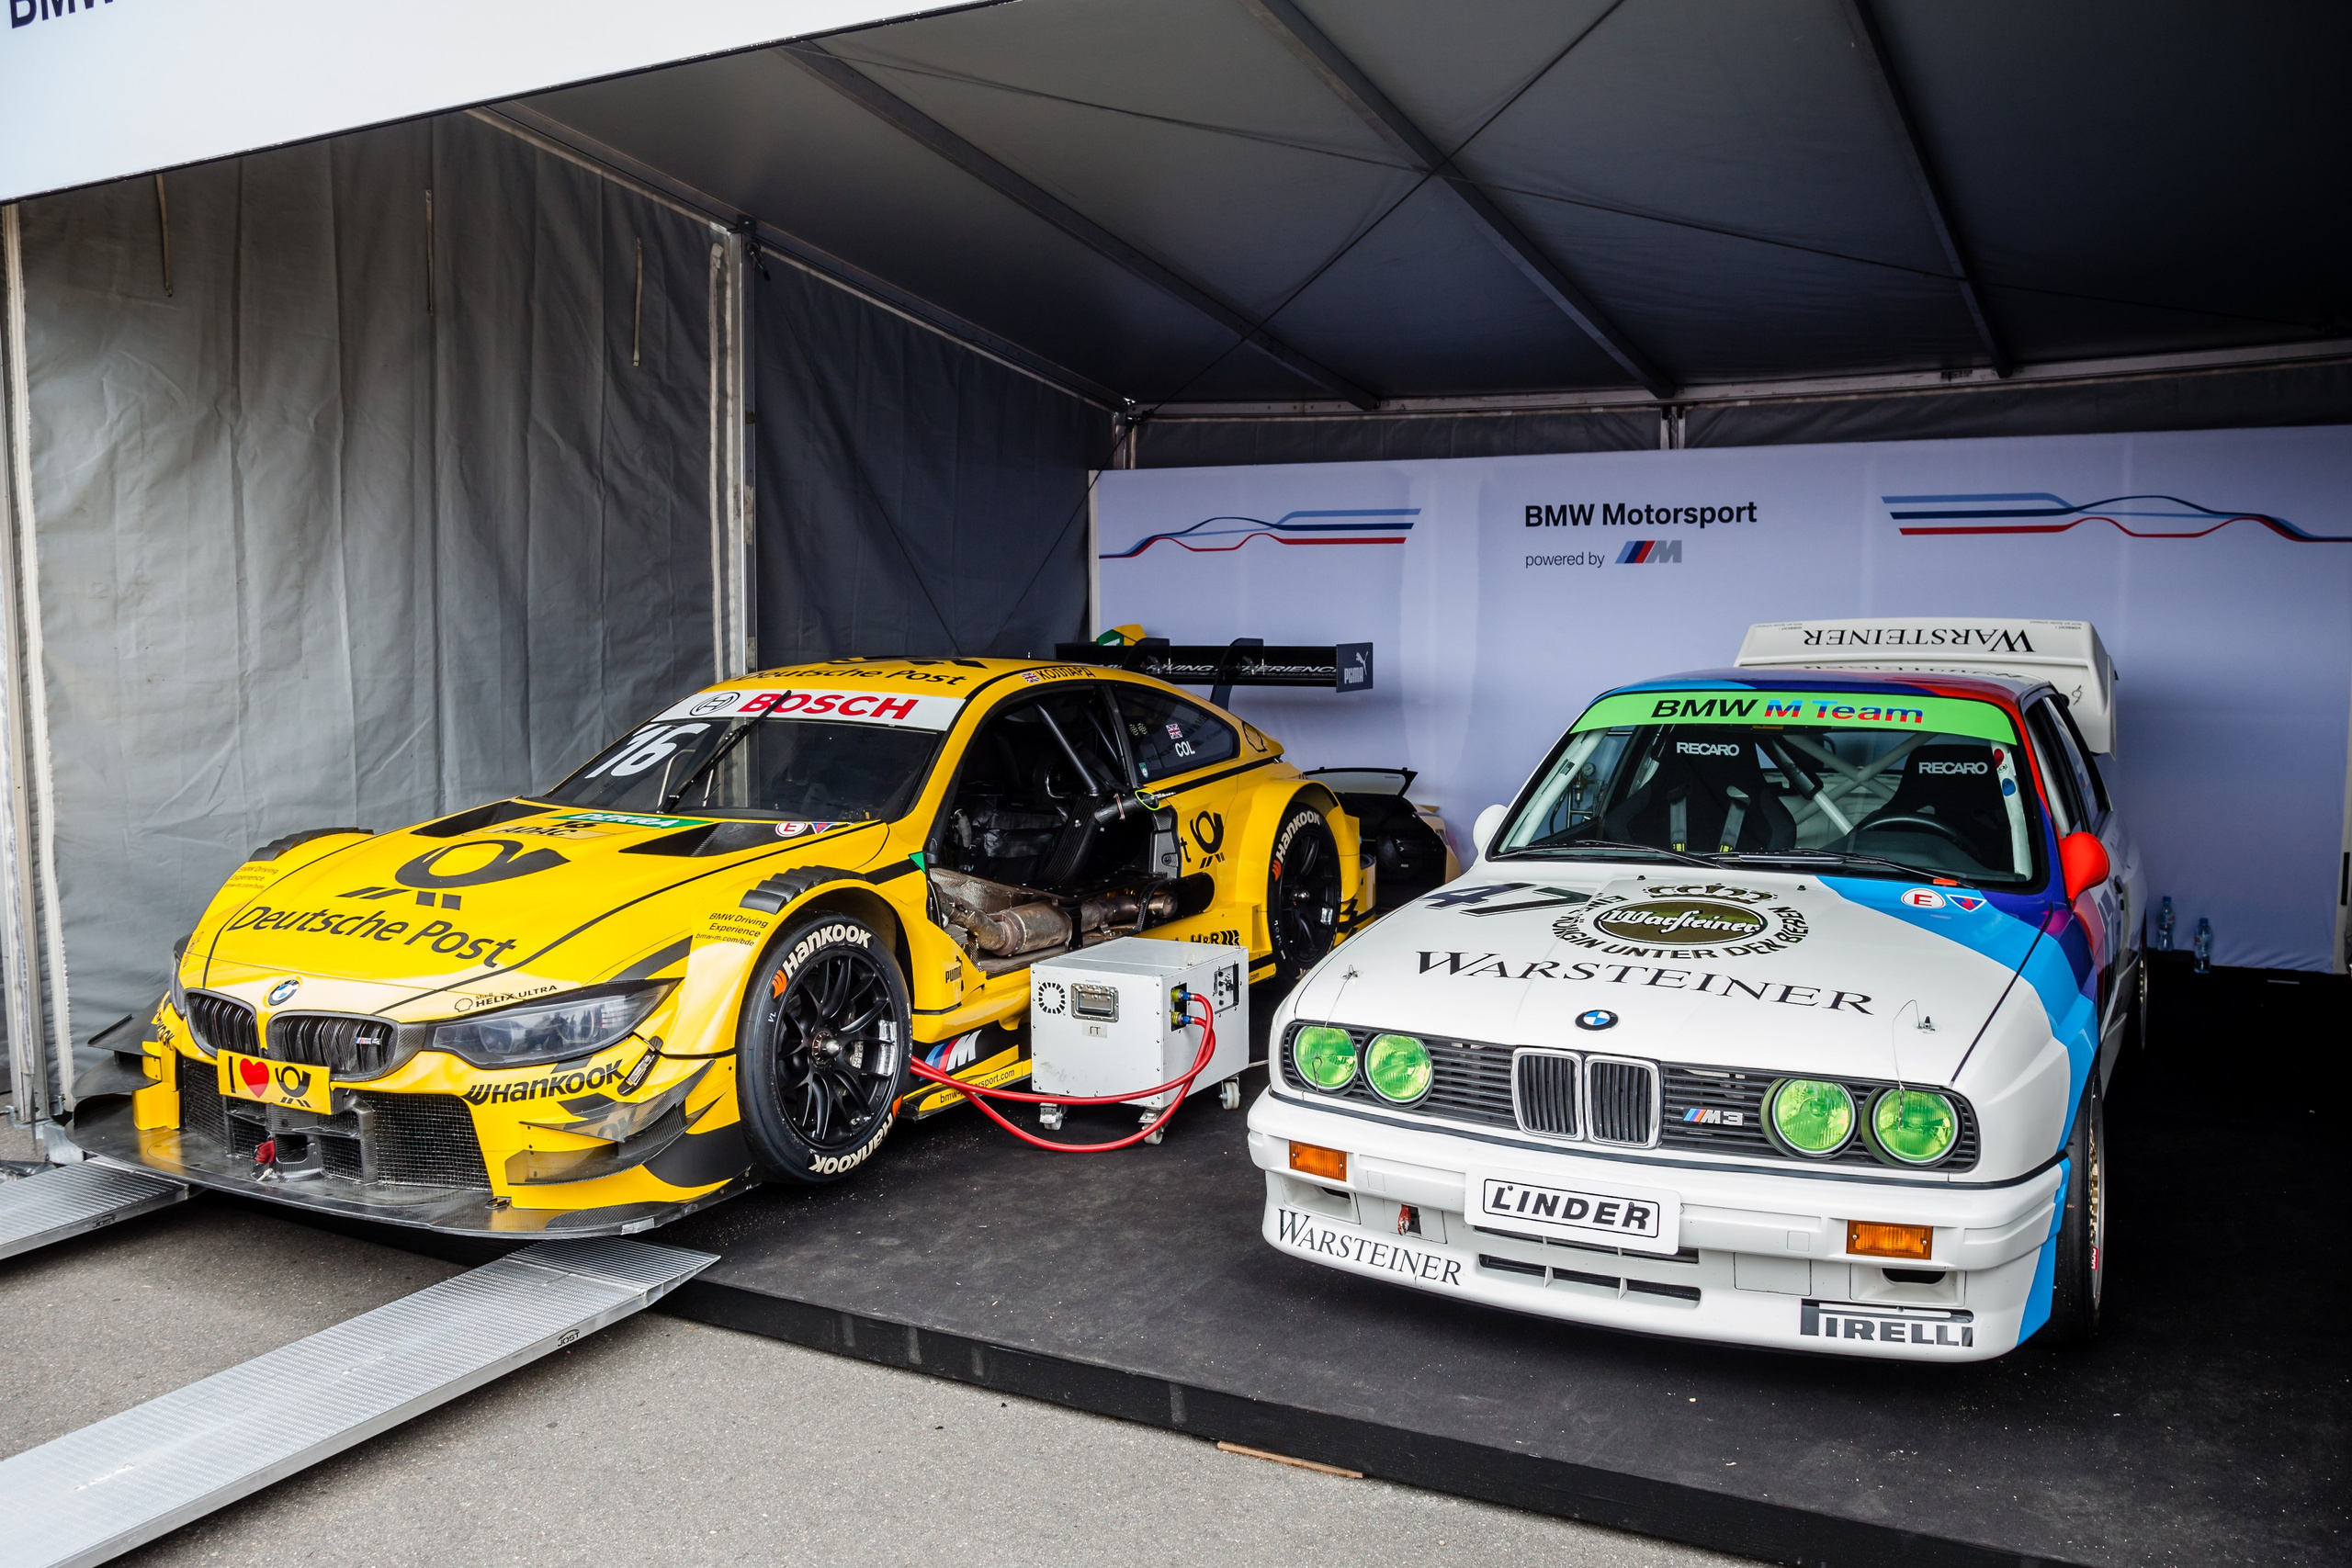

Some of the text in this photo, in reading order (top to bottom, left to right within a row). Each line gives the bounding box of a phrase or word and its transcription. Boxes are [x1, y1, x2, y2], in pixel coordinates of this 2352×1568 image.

[1525, 502, 1758, 529] BMW Motorsport
[1525, 551, 1584, 569] powered
[1589, 552, 1605, 568] by
[1804, 629, 2036, 653] WARSTEINER
[885, 670, 967, 685] Post
[1344, 667, 1363, 684] PUMA
[737, 694, 919, 719] BOSCH
[1651, 699, 1923, 724] BMW M Team
[585, 723, 711, 779] 16
[1175, 741, 1195, 757] COL
[1677, 742, 1740, 756] RECARO
[1919, 761, 1988, 774] RECARO
[784, 823, 797, 831] E
[1422, 883, 1592, 917] 47
[1914, 894, 1932, 906] E
[709, 913, 769, 929] BMW Driving
[709, 923, 761, 937] Experience
[1601, 943, 1719, 959] UNTER
[1722, 938, 1789, 957] DEN
[1767, 906, 1809, 943] BIEREN
[227, 906, 517, 968] Deutsche Post
[695, 932, 754, 946] bmw-m.com/bde
[1416, 951, 1874, 1015] WARSTEINER
[476, 985, 558, 1007] HELIX ULTRA
[228, 1055, 236, 1094] I
[1700, 1110, 1743, 1125] M3
[1491, 1187, 1651, 1230] LINDER
[1278, 1209, 1462, 1286] WARSTEINER
[1800, 1298, 1974, 1348] PIRELLI
